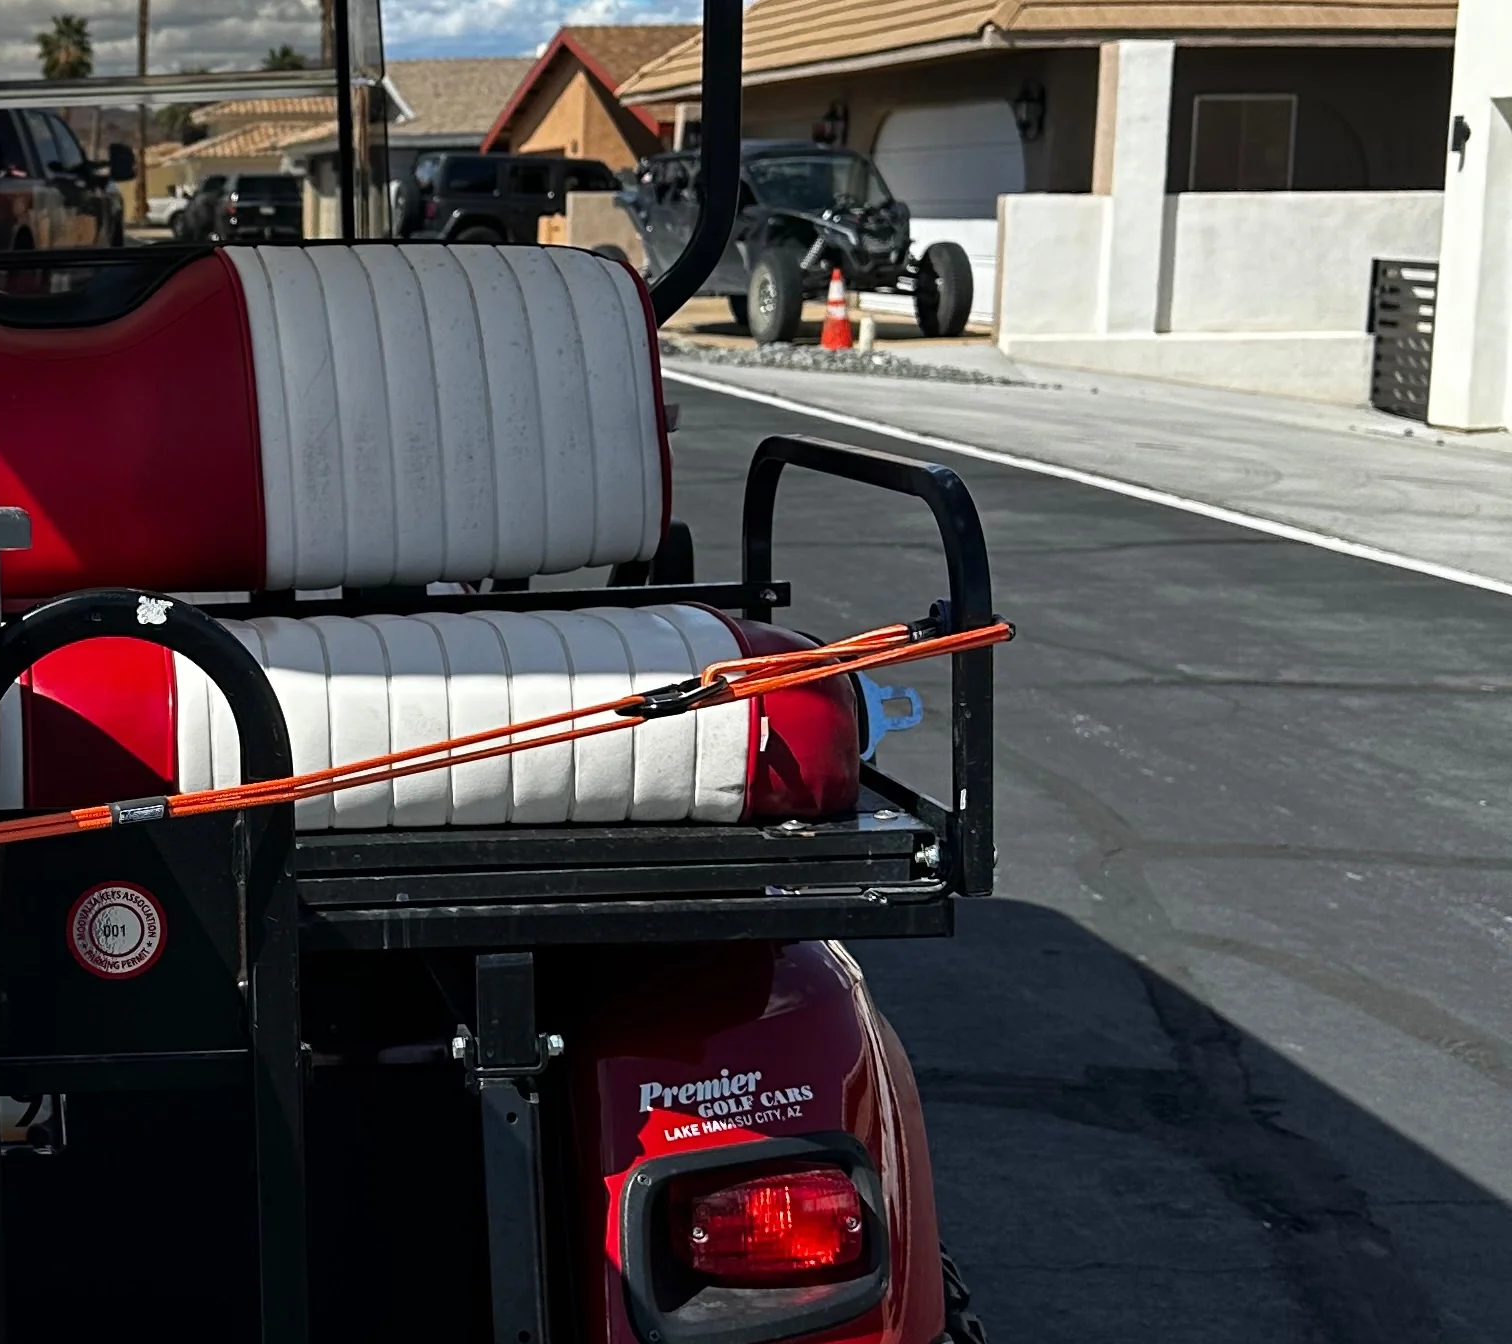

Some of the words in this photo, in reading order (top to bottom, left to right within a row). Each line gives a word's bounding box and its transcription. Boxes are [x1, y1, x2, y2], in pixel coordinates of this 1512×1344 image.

[103, 924, 127, 937] 001
[123, 890, 157, 938] ASSOCIATION
[85, 949, 120, 970] PARKING
[121, 947, 150, 969] PERMIT
[639, 1068, 762, 1113] Premier
[698, 1096, 752, 1117] GOLF
[760, 1084, 814, 1107] CARS
[664, 1123, 701, 1142] LAKE
[703, 1113, 753, 1135] HAVASU
[755, 1108, 786, 1126] CITY,
[788, 1106, 803, 1118] AZ
